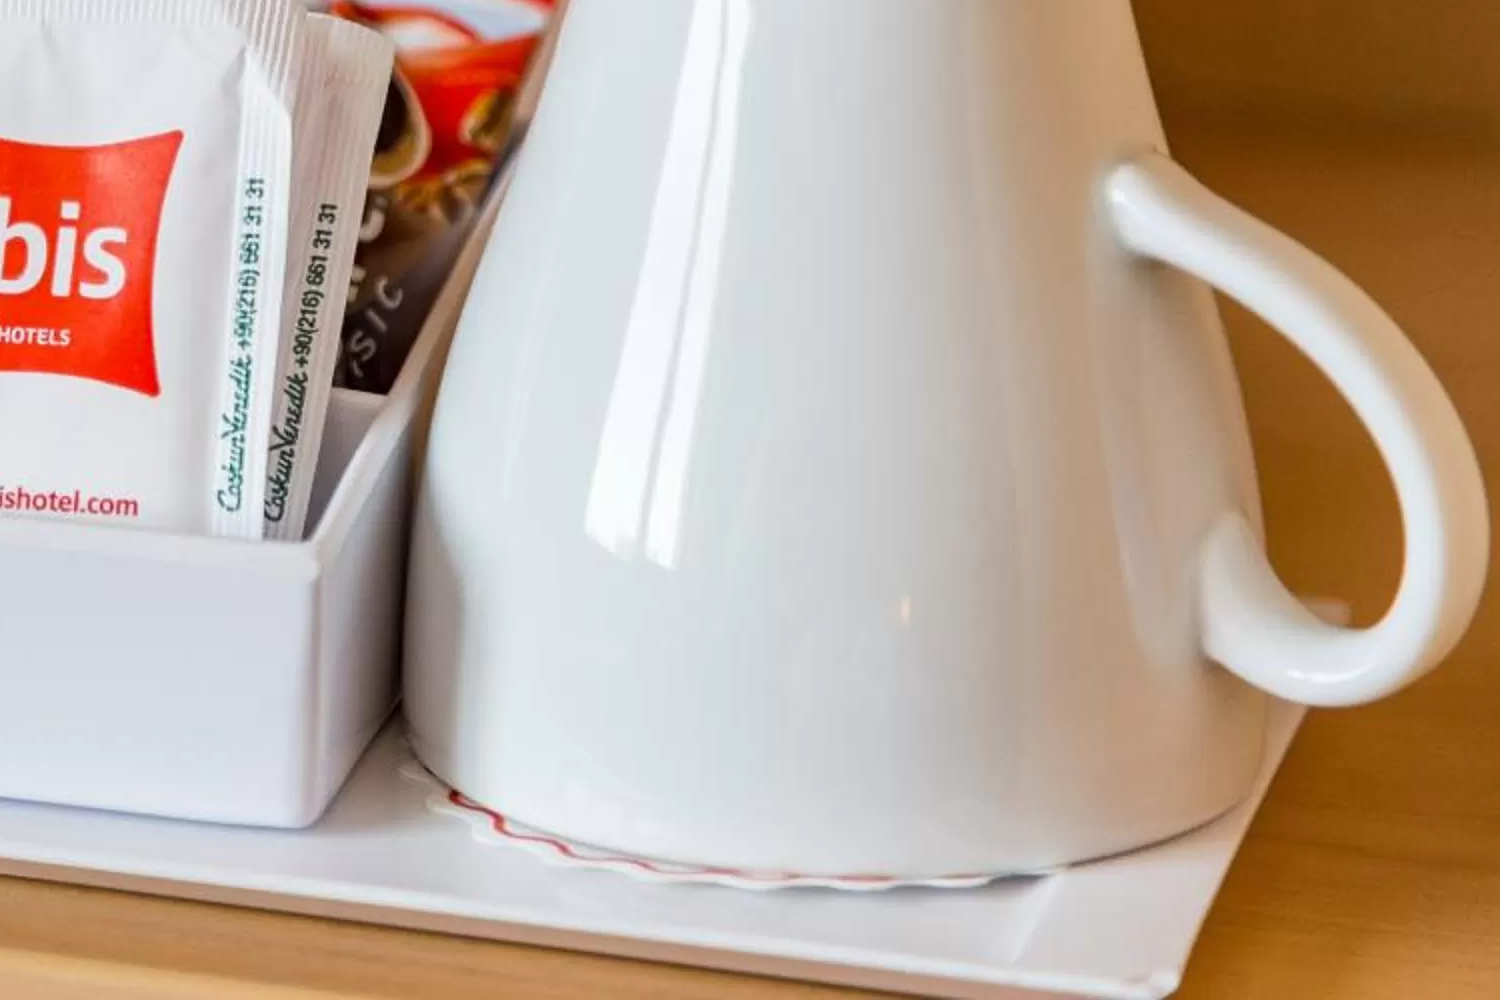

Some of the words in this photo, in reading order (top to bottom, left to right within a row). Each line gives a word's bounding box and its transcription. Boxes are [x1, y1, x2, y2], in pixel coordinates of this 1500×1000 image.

[245, 177, 265, 199] 31
[243, 205, 263, 227] 31
[317, 203, 338, 225] 31
[239, 233, 261, 265] 661
[312, 228, 333, 250] 31
[305, 255, 329, 287] 661
[292, 287, 325, 369] +90(216)
